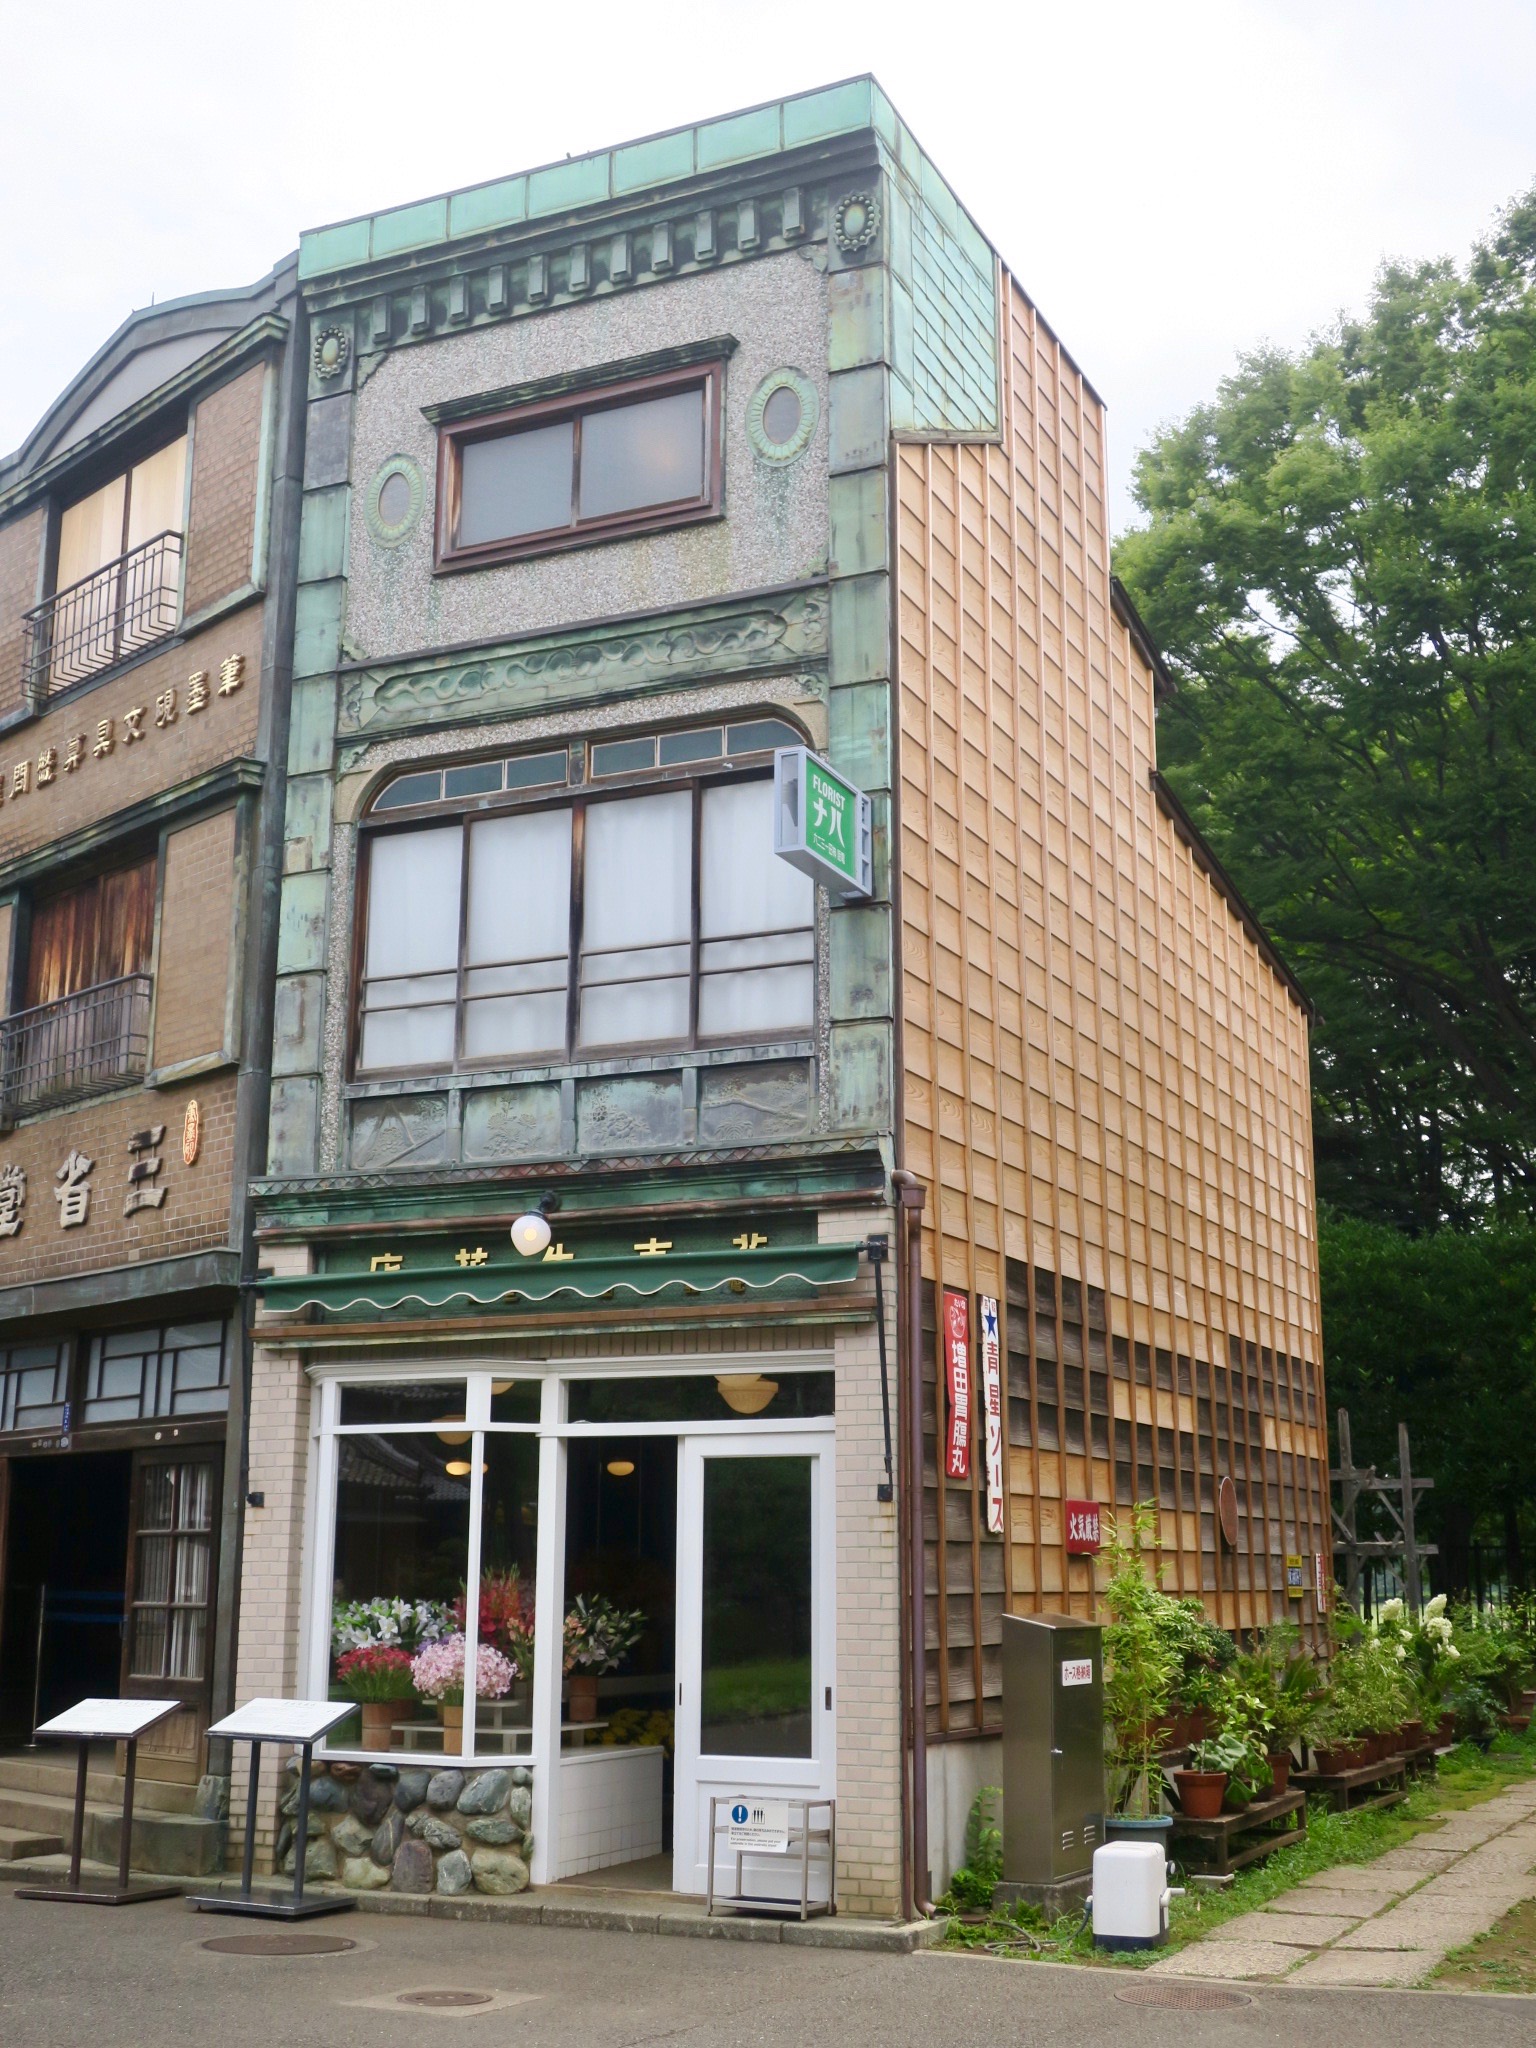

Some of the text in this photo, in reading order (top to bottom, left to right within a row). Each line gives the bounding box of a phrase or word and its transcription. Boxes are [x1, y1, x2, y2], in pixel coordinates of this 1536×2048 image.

[813, 774, 845, 811] FLORIST
[987, 1341, 1003, 1529] 青星ソース
[1070, 1512, 1099, 1542] 火気厳禁
